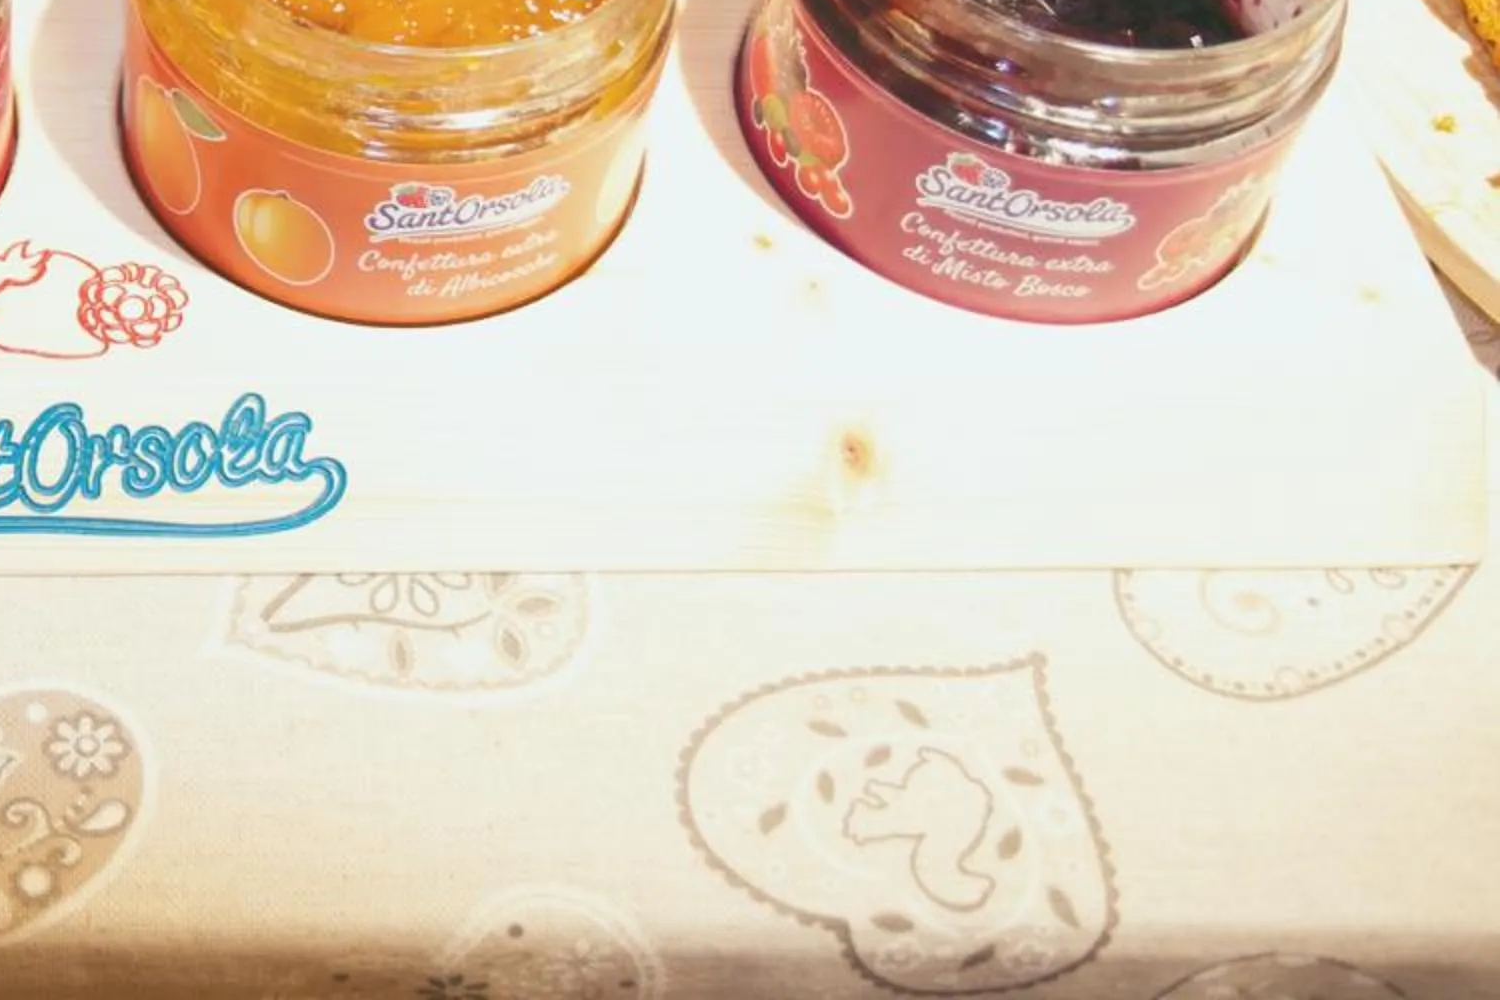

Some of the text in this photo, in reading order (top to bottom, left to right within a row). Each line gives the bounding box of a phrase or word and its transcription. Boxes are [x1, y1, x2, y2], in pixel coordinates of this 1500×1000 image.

[918, 168, 1120, 223] SantOrsola
[357, 249, 493, 281] Confettura
[900, 211, 1041, 269] Confettura
[1044, 254, 1115, 273] extra
[406, 280, 437, 297] di
[902, 245, 1092, 297] di Misto Bosco
